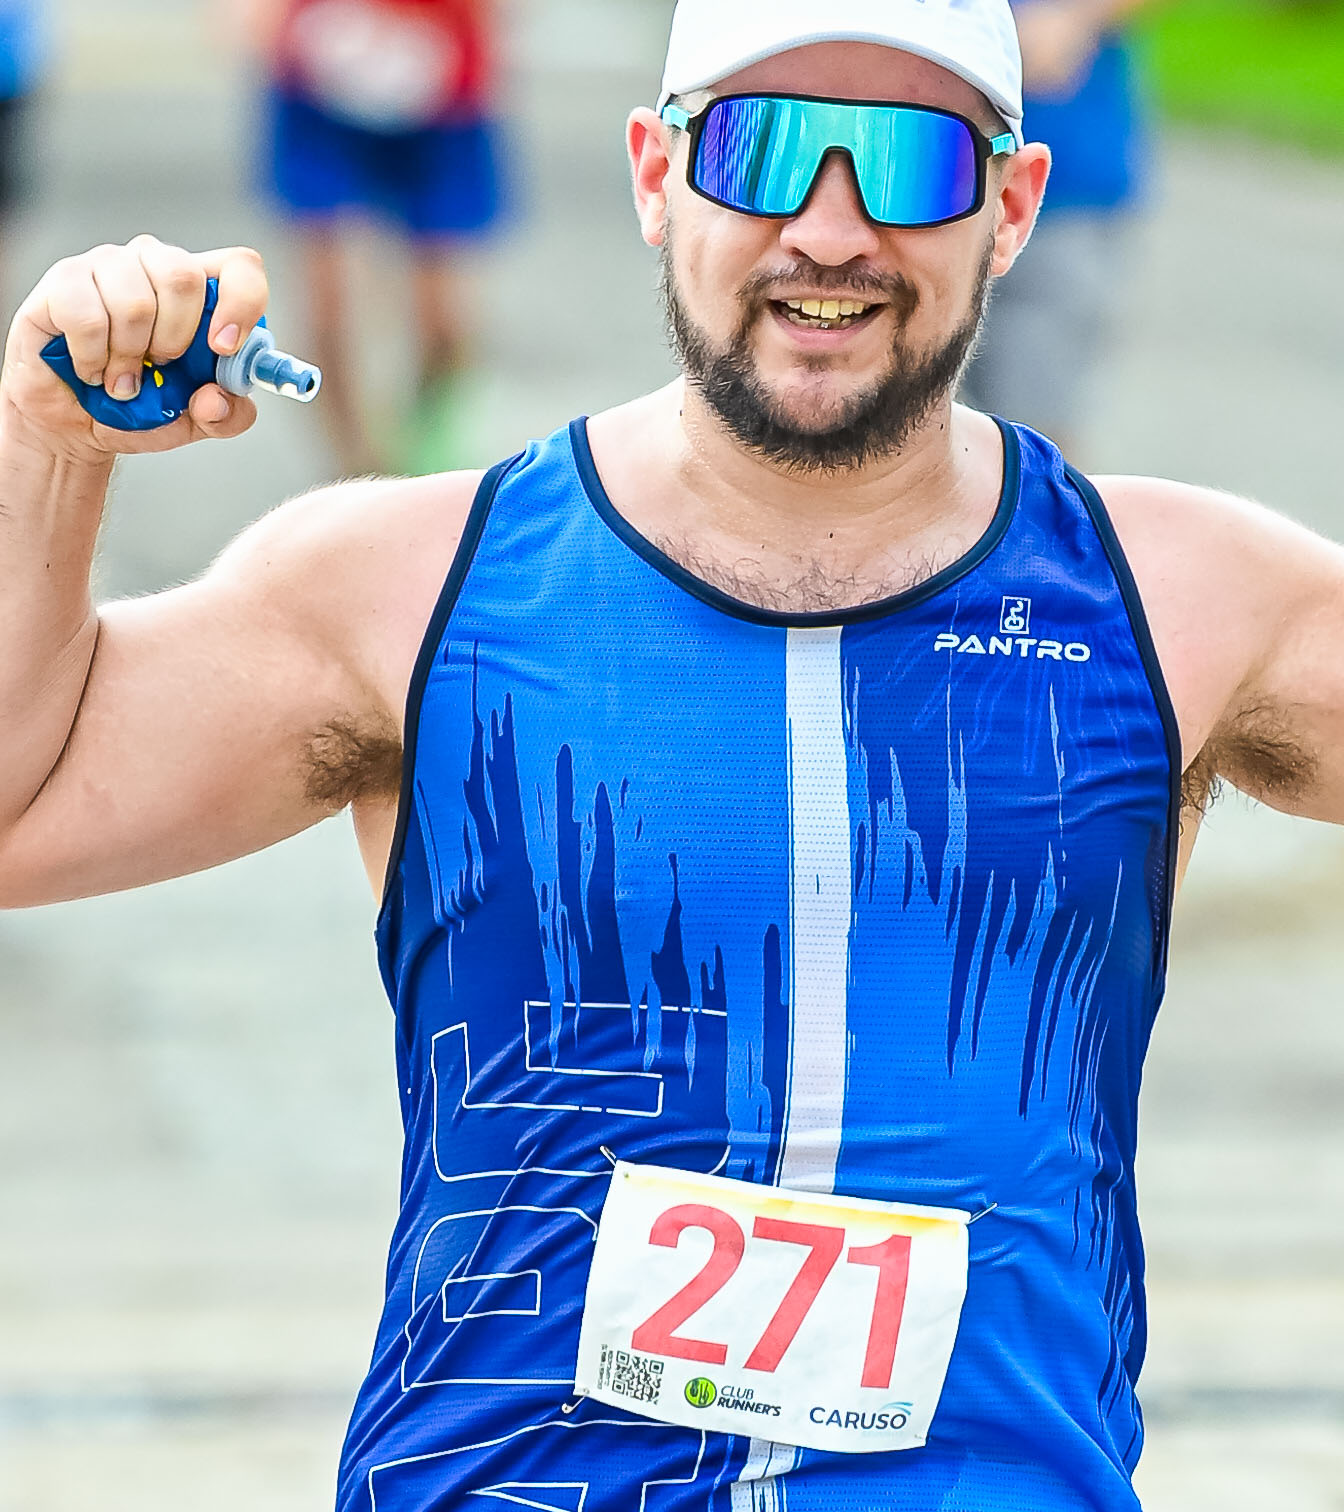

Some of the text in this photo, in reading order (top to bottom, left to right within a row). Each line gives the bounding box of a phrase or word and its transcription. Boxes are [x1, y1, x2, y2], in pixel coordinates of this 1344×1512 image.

[933, 633, 1091, 663] PANTRO
[630, 1203, 913, 1389] 271
[721, 1385, 755, 1400] CLUB
[717, 1396, 782, 1417] RUNNER'S
[809, 1406, 907, 1430] CARUSO
